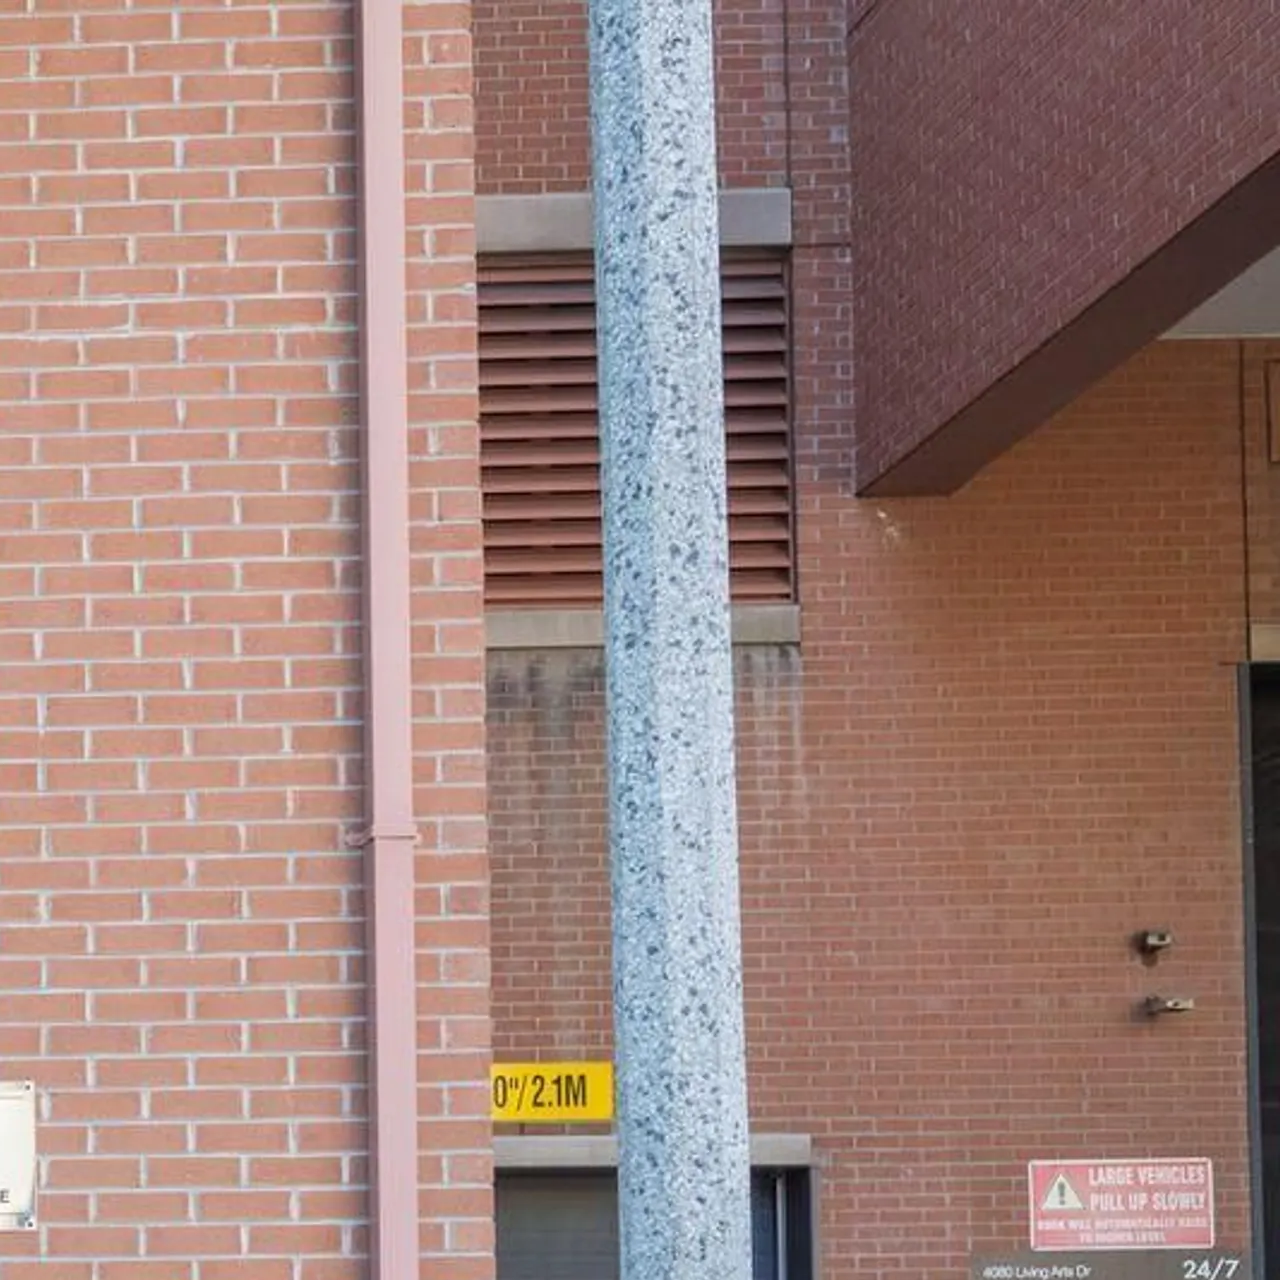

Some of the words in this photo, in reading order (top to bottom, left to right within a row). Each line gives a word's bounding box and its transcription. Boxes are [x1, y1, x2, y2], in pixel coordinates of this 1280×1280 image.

[1088, 1166, 1135, 1186] LARGE
[1137, 1165, 1205, 1185] VEHICLES
[1090, 1193, 1125, 1212] PULL
[1128, 1192, 1150, 1211] UP
[1152, 1191, 1206, 1211] SLOWLY
[1015, 1264, 1049, 1280] Living
[1051, 1264, 1074, 1279] Arts
[1076, 1263, 1092, 1279] Dr
